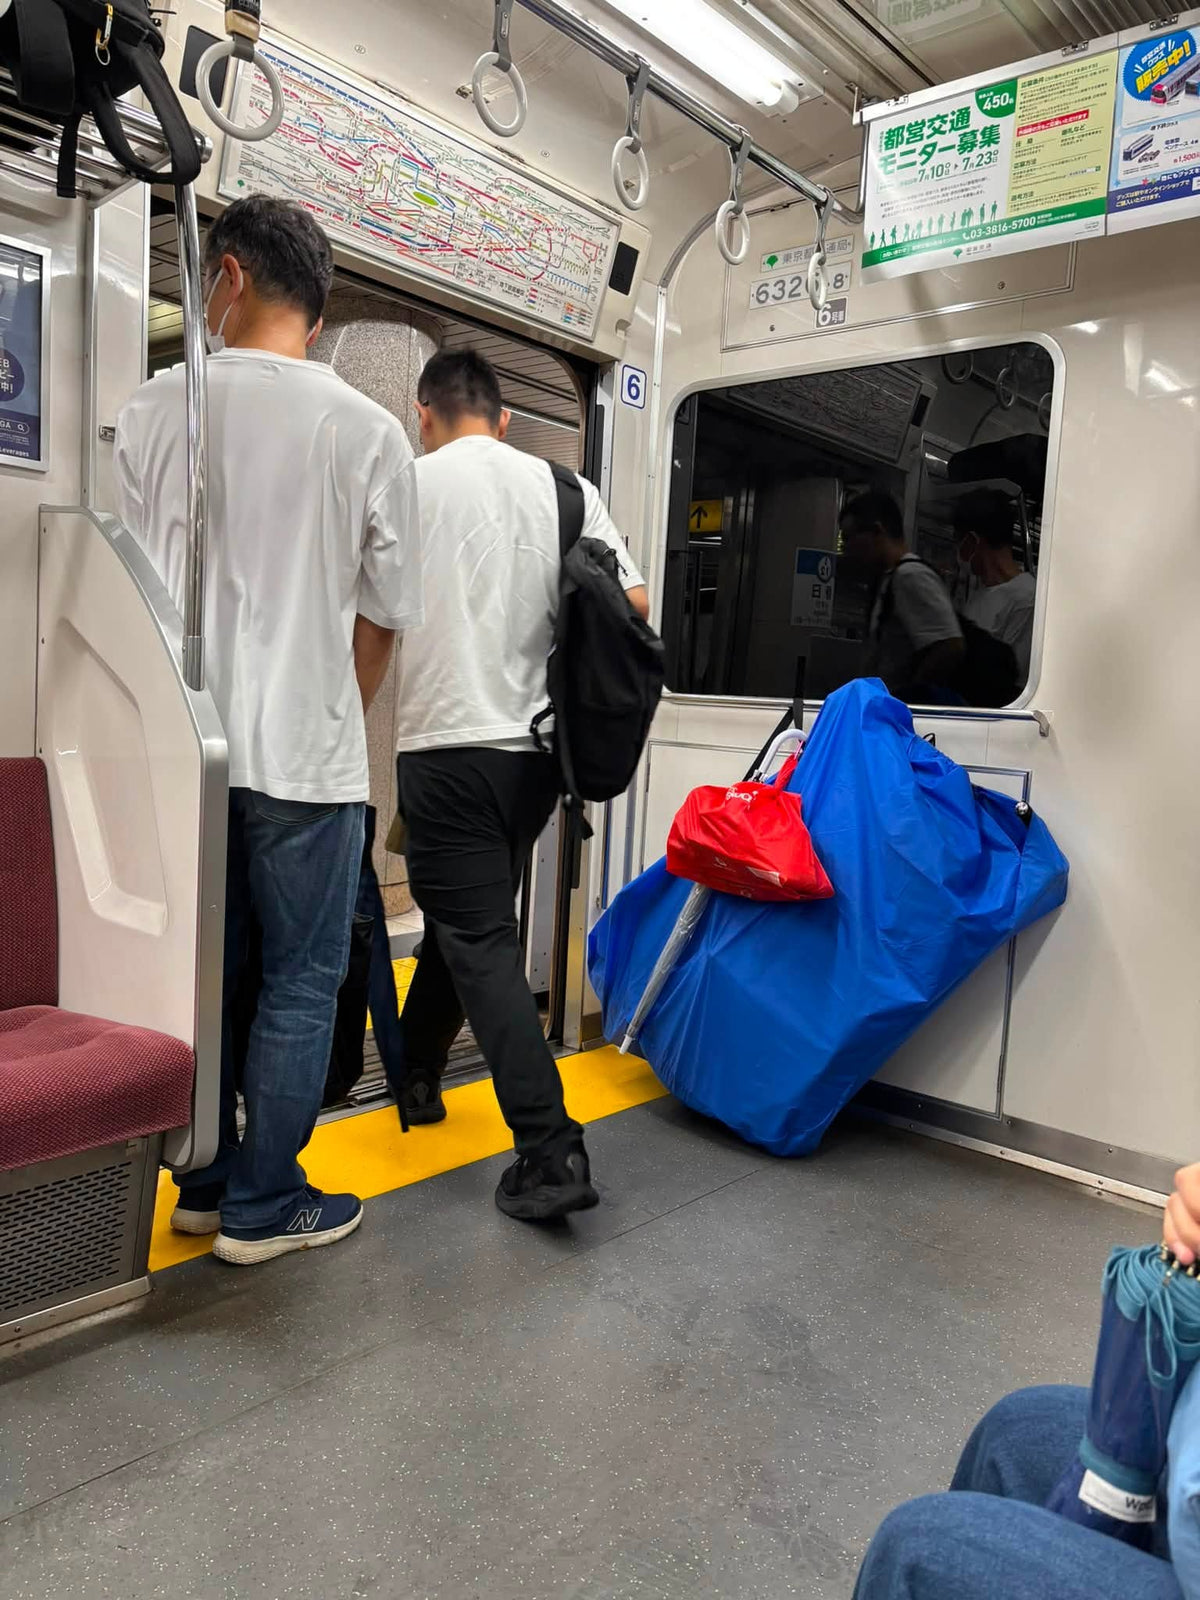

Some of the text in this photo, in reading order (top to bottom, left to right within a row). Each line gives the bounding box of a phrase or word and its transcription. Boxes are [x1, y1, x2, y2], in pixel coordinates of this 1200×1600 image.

[1136, 39, 1191, 93] 販売中!
[883, 106, 971, 151] 都営交通
[878, 124, 1001, 176] モニター募集
[970, 216, 1036, 239] 03-3816-5700
[782, 239, 848, 264] 東京都通局
[627, 374, 640, 400] 6
[286, 1208, 322, 1231] N
